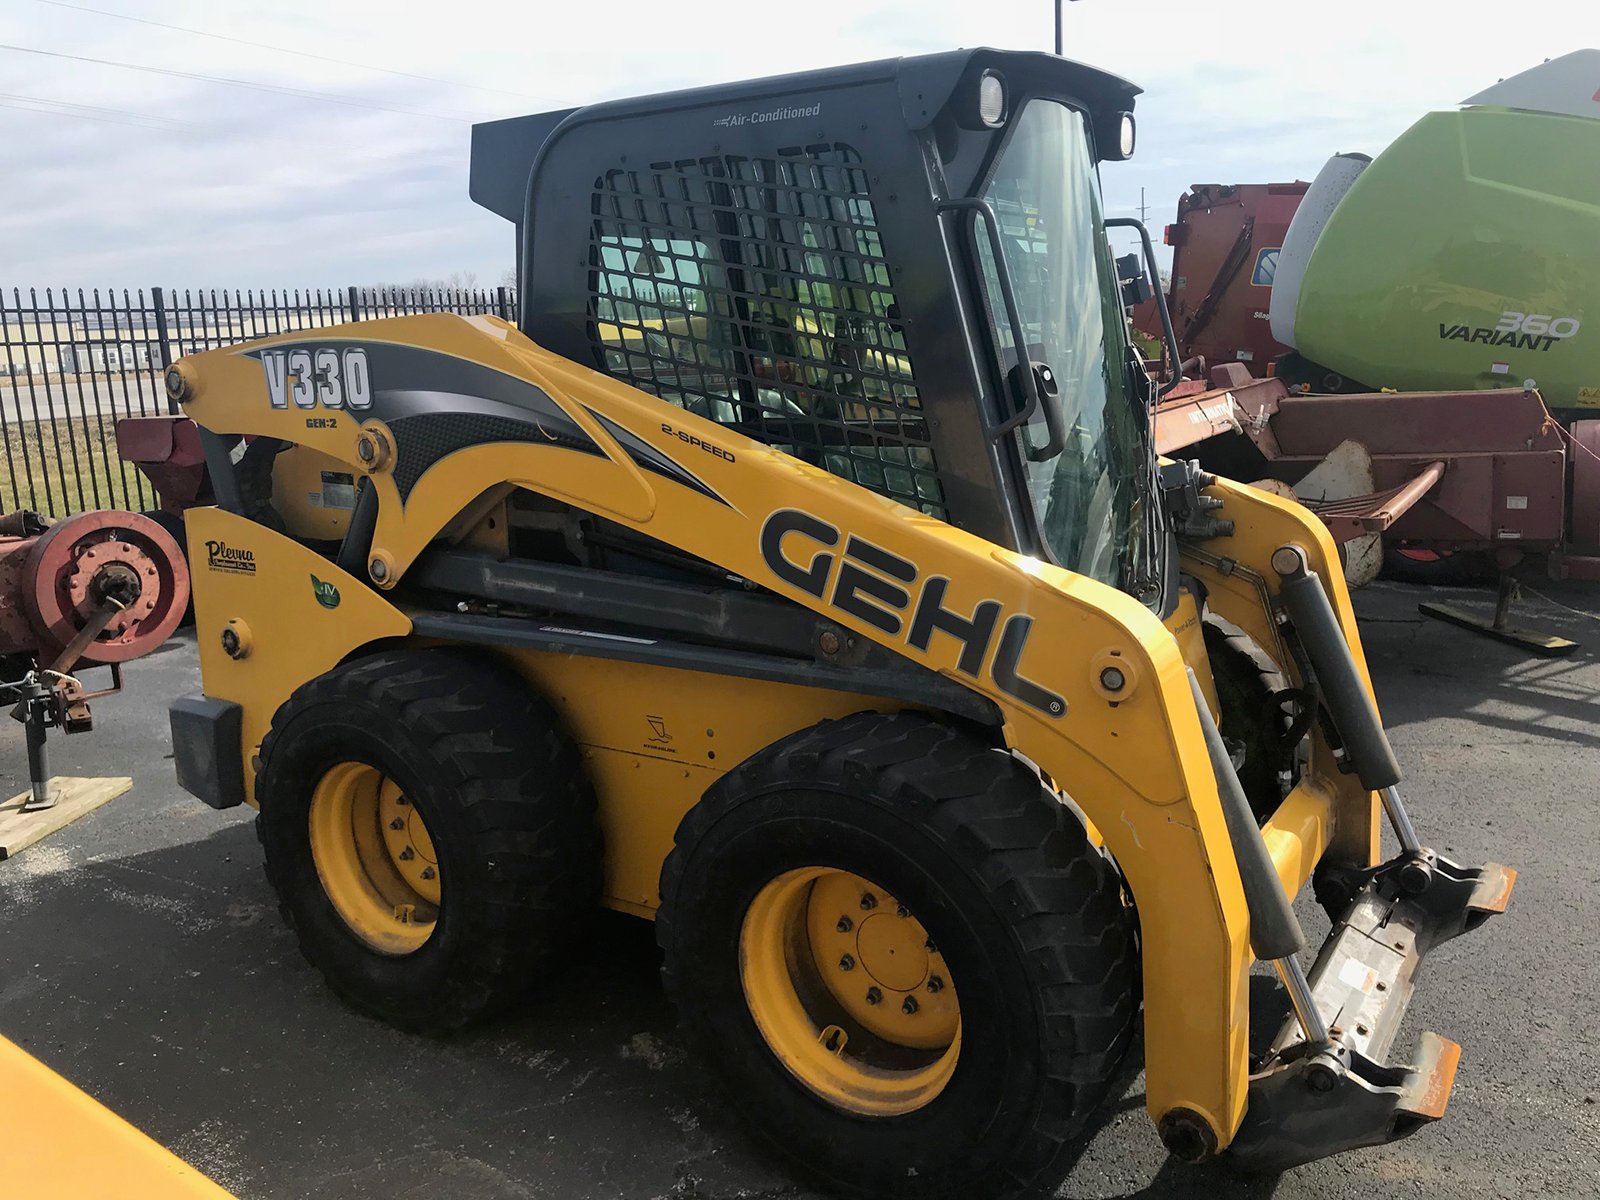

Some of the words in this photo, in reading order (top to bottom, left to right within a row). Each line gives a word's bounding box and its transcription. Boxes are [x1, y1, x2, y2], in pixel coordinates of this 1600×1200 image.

[729, 102, 821, 127] Air-Conditioned
[1253, 311, 1270, 321] Silag
[1495, 311, 1580, 338] 360
[1439, 323, 1561, 352] VARIANT
[260, 347, 374, 411] V330
[306, 418, 337, 428] GEN:2
[661, 423, 736, 463] 2-SPEED
[205, 540, 256, 565] Plevna
[759, 507, 1069, 718] GEHL
